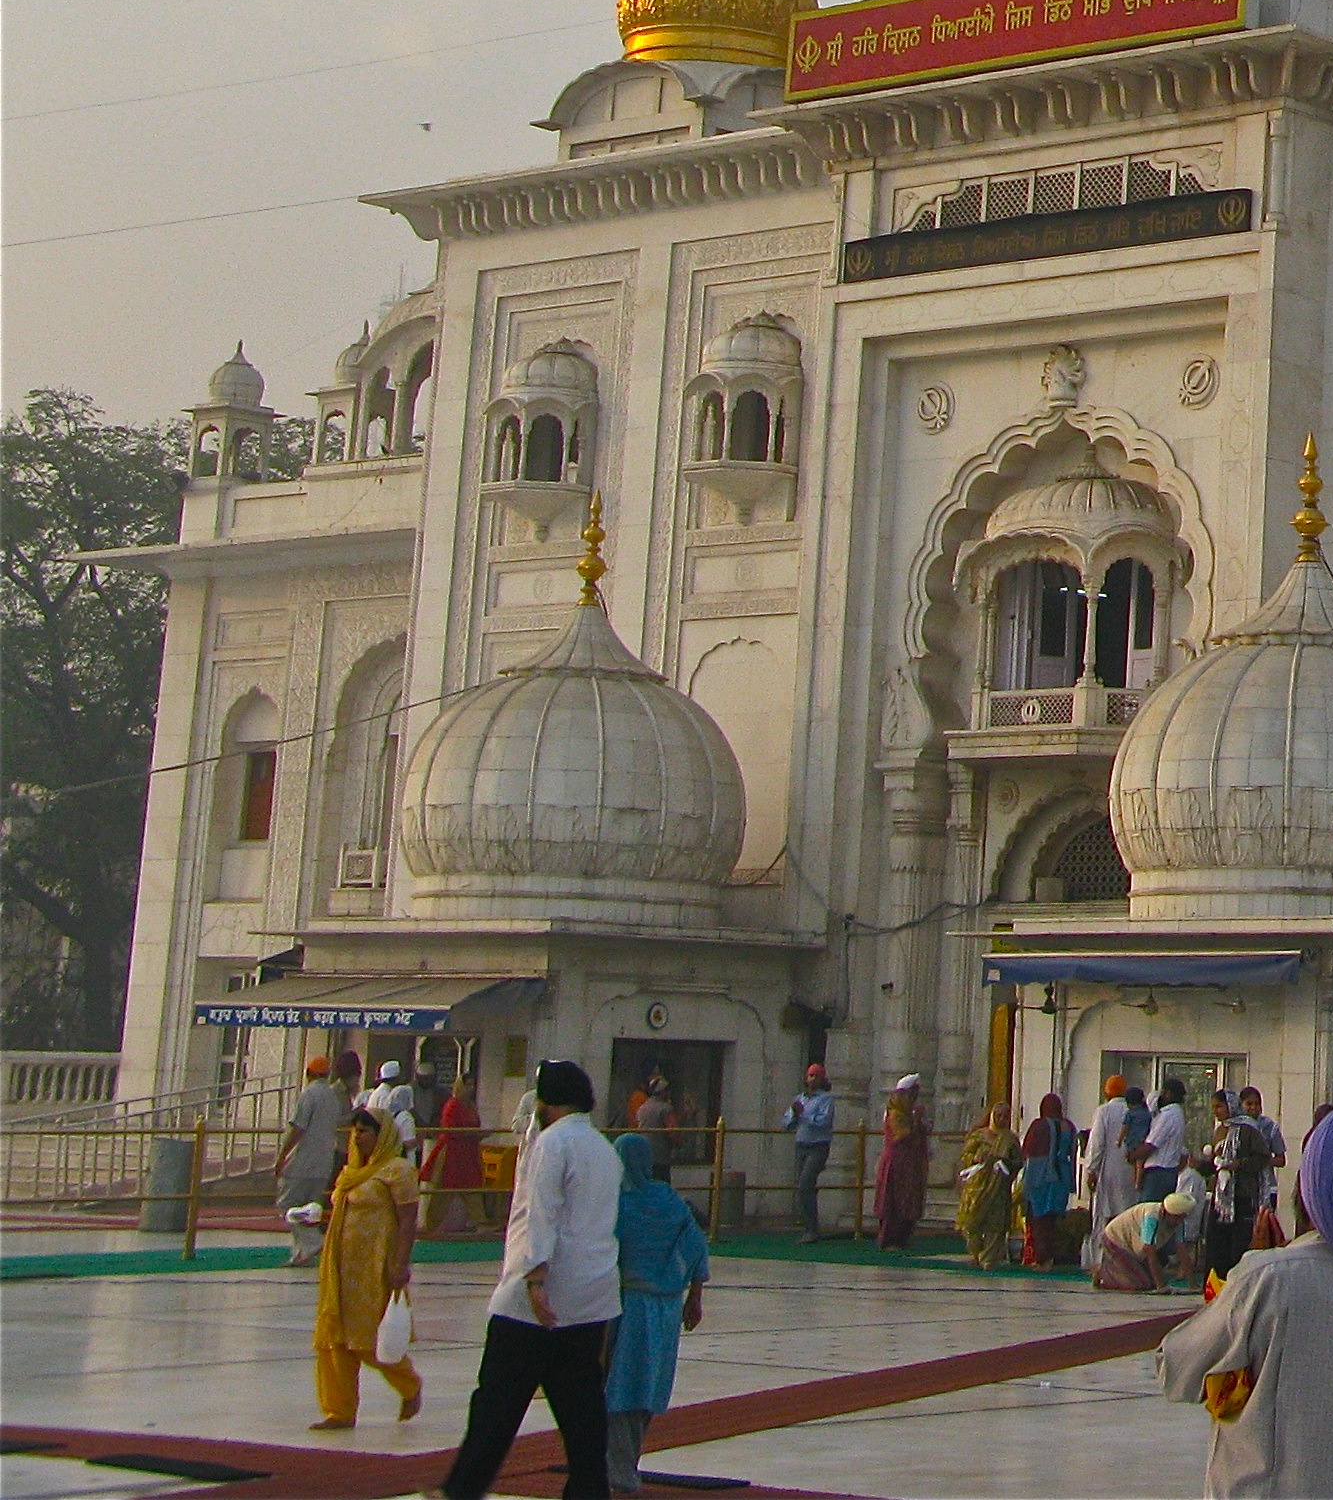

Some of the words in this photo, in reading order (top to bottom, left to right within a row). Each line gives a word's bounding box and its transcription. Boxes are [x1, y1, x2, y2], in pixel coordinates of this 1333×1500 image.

[826, 31, 844, 67] ਸ੍ਰੀ
[852, 26, 879, 57] ਹਰਿ
[1005, 1, 1033, 31] ਜਿਸ
